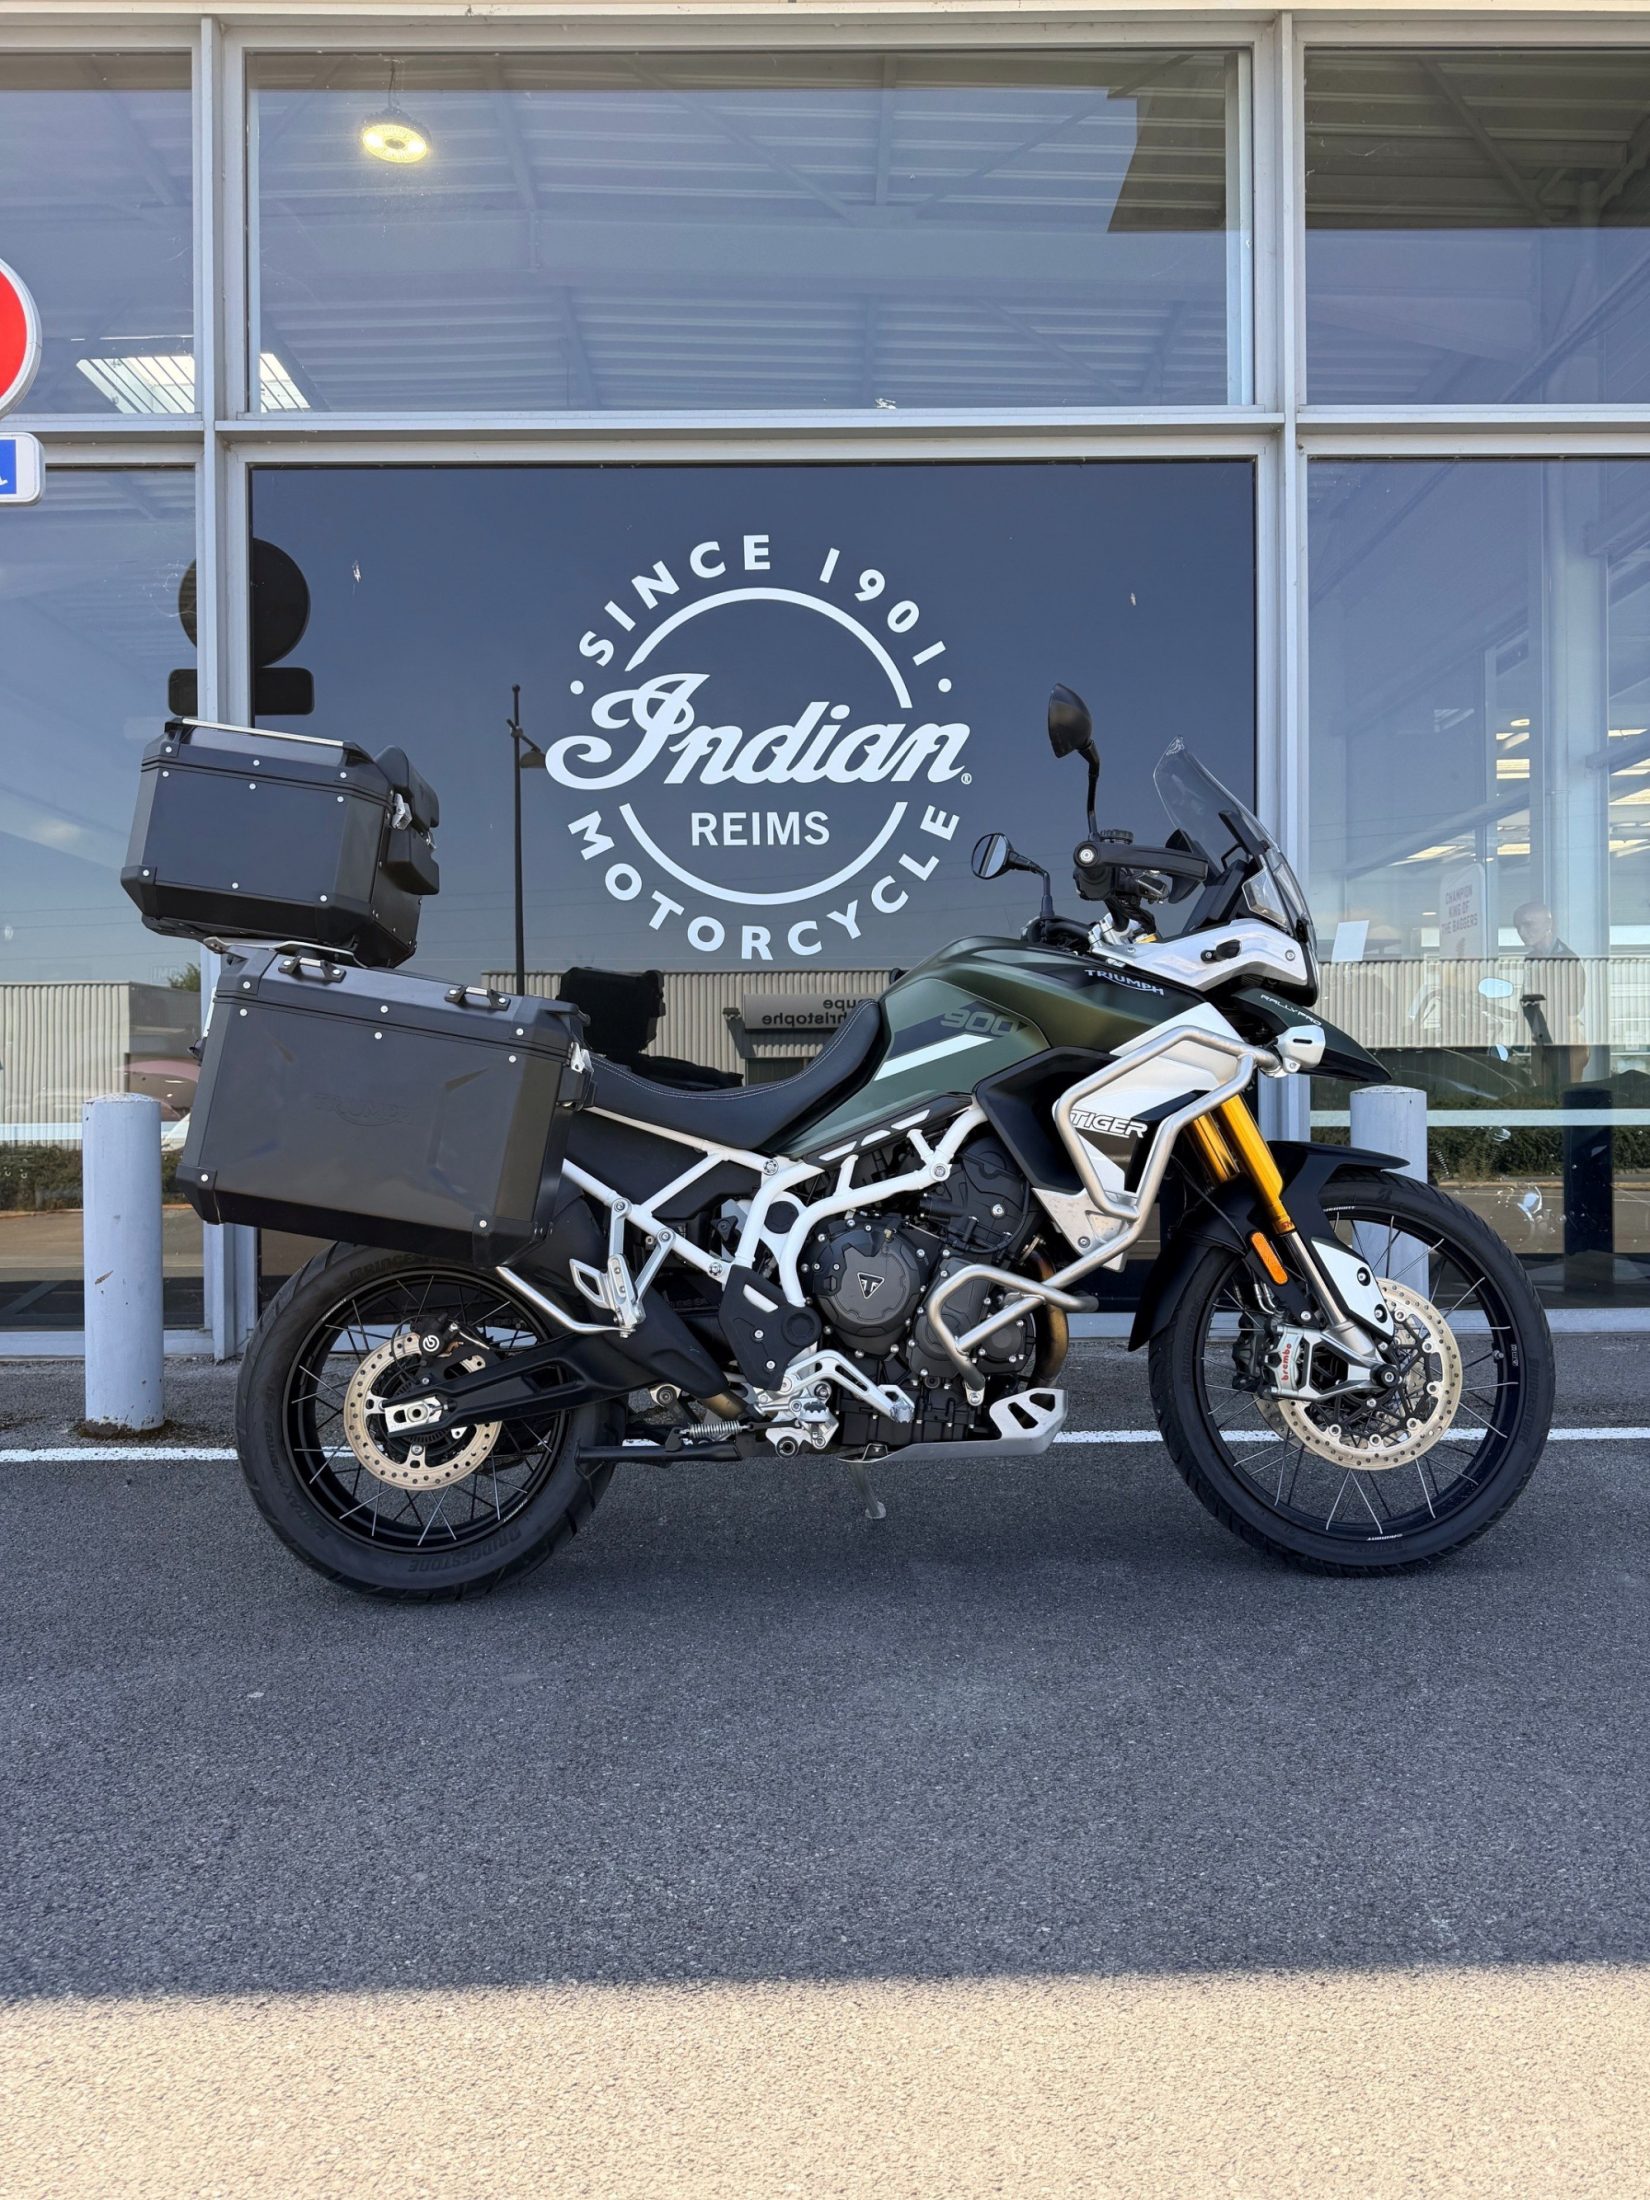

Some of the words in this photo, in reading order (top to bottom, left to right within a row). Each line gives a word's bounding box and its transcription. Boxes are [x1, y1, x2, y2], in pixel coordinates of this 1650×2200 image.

[579, 534, 771, 667] SINCE
[819, 547, 947, 667] 1901
[545, 673, 971, 790] Indian
[690, 811, 831, 847] REIMS
[567, 804, 960, 962] MOTORCYCLE
[1084, 969, 1165, 996] TRIUMPH
[940, 1008, 1018, 1036] 900
[1069, 1109, 1149, 1139] TIGER
[1281, 1343, 1292, 1381] brembo
[407, 1526, 523, 1574] BRIDGESTONE
